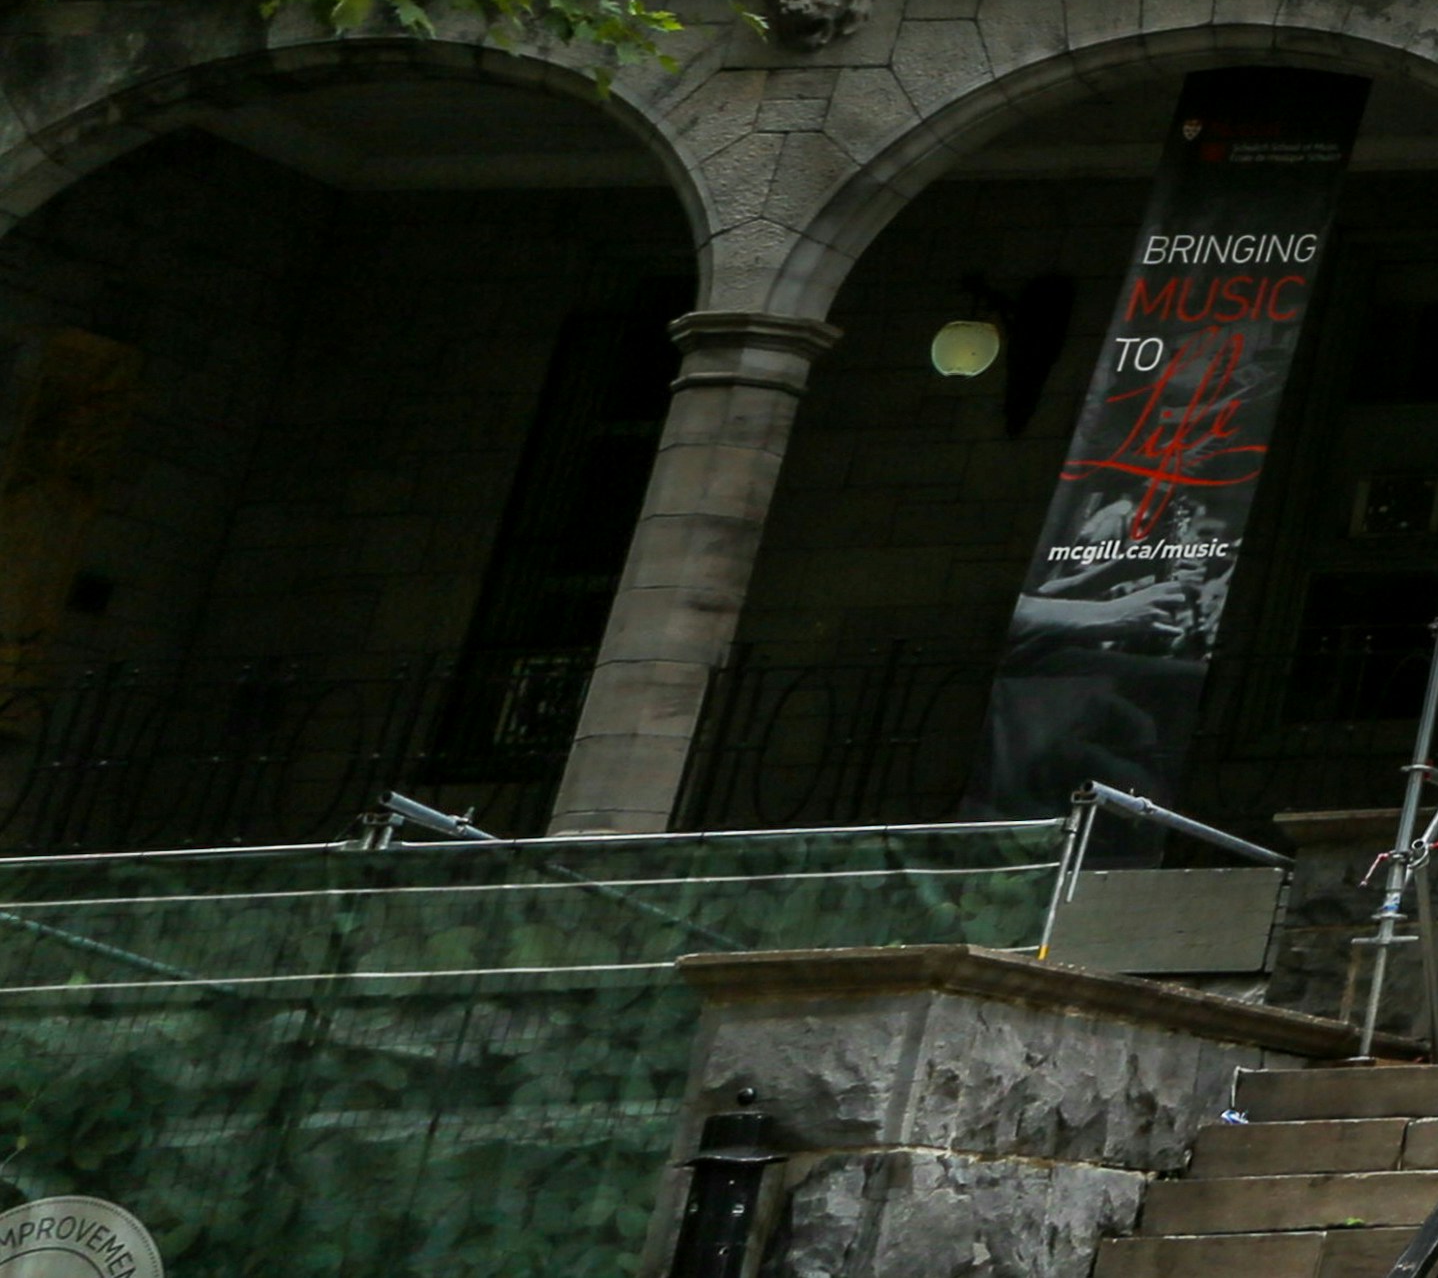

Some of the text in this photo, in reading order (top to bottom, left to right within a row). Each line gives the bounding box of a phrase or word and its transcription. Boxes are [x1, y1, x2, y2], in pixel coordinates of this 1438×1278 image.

[1142, 233, 1319, 265] BRINGING
[1124, 275, 1307, 322] MUSIC
[1115, 337, 1164, 372] TO
[1059, 325, 1268, 540] Life
[1047, 538, 1229, 565] mcgill.ca/music
